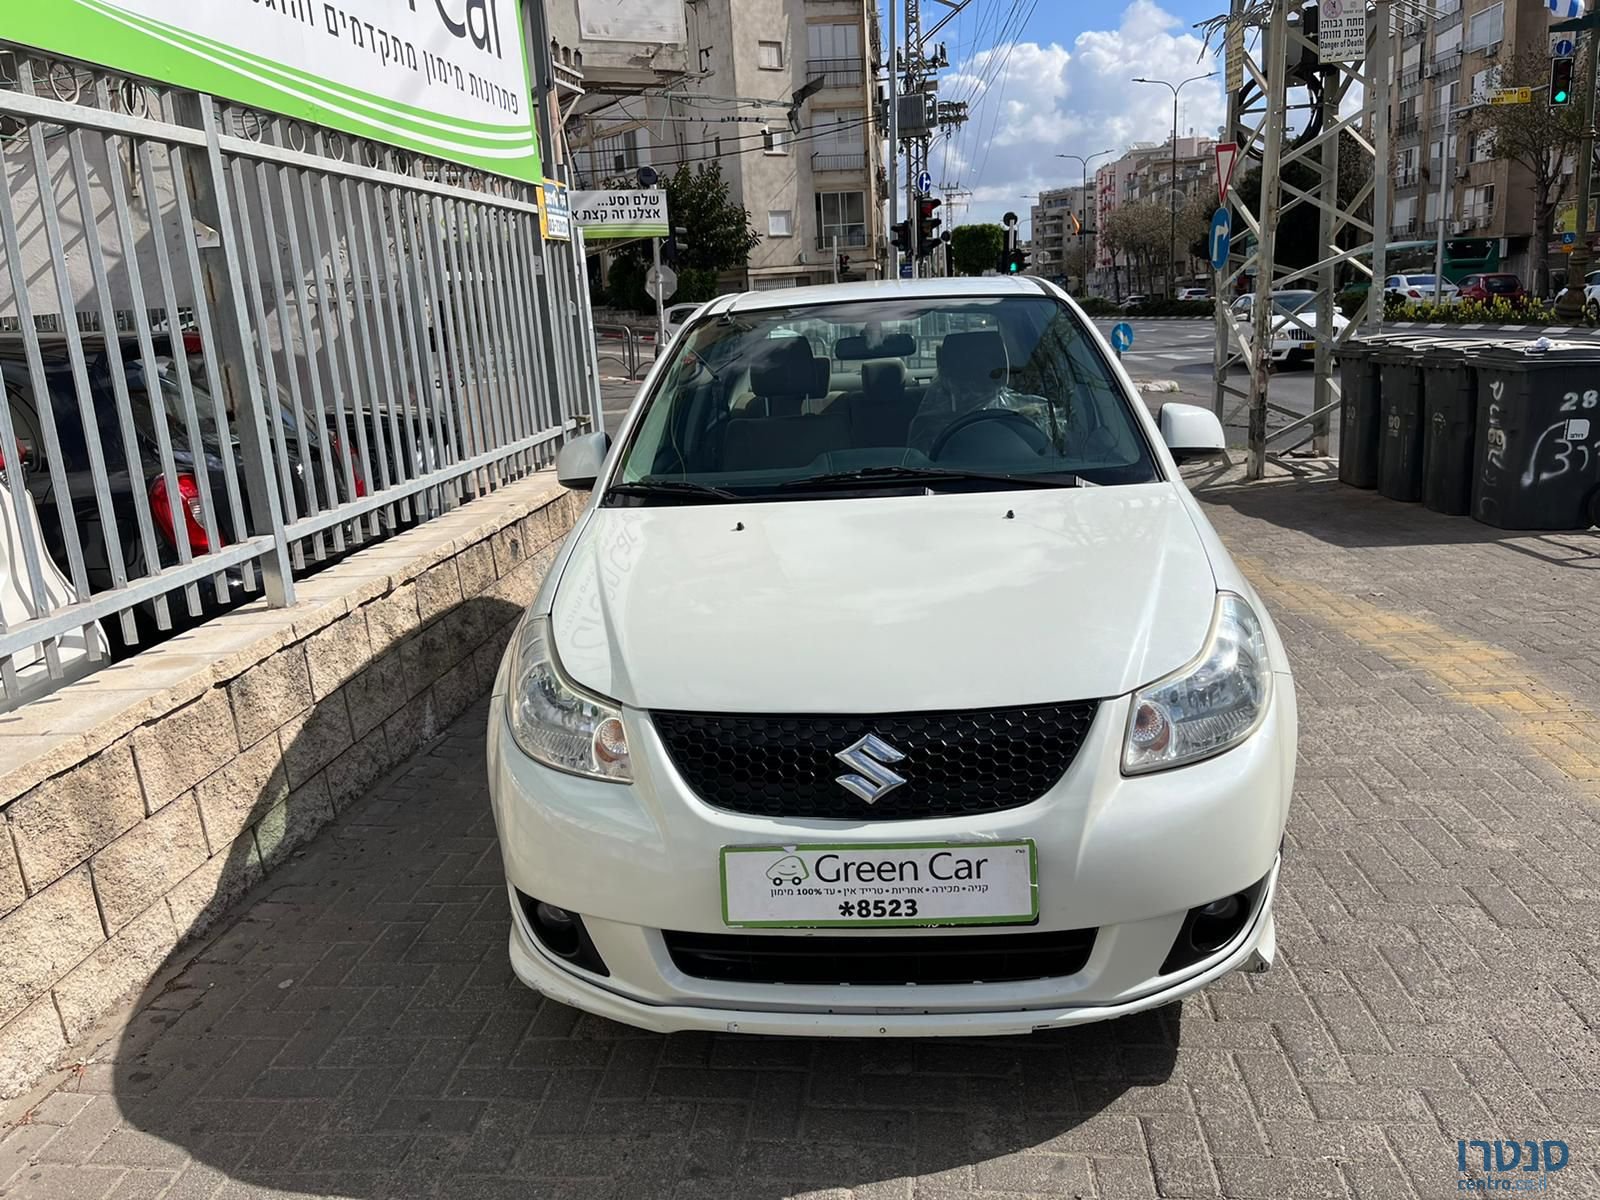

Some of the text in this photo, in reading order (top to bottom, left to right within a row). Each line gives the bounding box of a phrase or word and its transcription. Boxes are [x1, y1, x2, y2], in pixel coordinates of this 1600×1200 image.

[1321, 18, 1364, 29] מתח גבוה!
[323, 3, 418, 72] מתקדמים
[1320, 28, 1365, 40] סכנת מוות!
[1321, 41, 1339, 51] Danger
[1340, 40, 1347, 48] of
[423, 49, 465, 92] מימון
[468, 72, 519, 115] פתרונות
[597, 193, 660, 207] שלם וסע...
[583, 209, 608, 223] קצת
[612, 209, 624, 219] זה
[628, 207, 661, 219] אצלנו
[814, 852, 988, 883] Green Car
[770, 888, 794, 898] מימון
[843, 887, 857, 897] אין
[860, 887, 884, 895] טרייד
[891, 886, 924, 895] אחריות
[931, 885, 960, 894] מכירה
[967, 885, 989, 894] קניה
